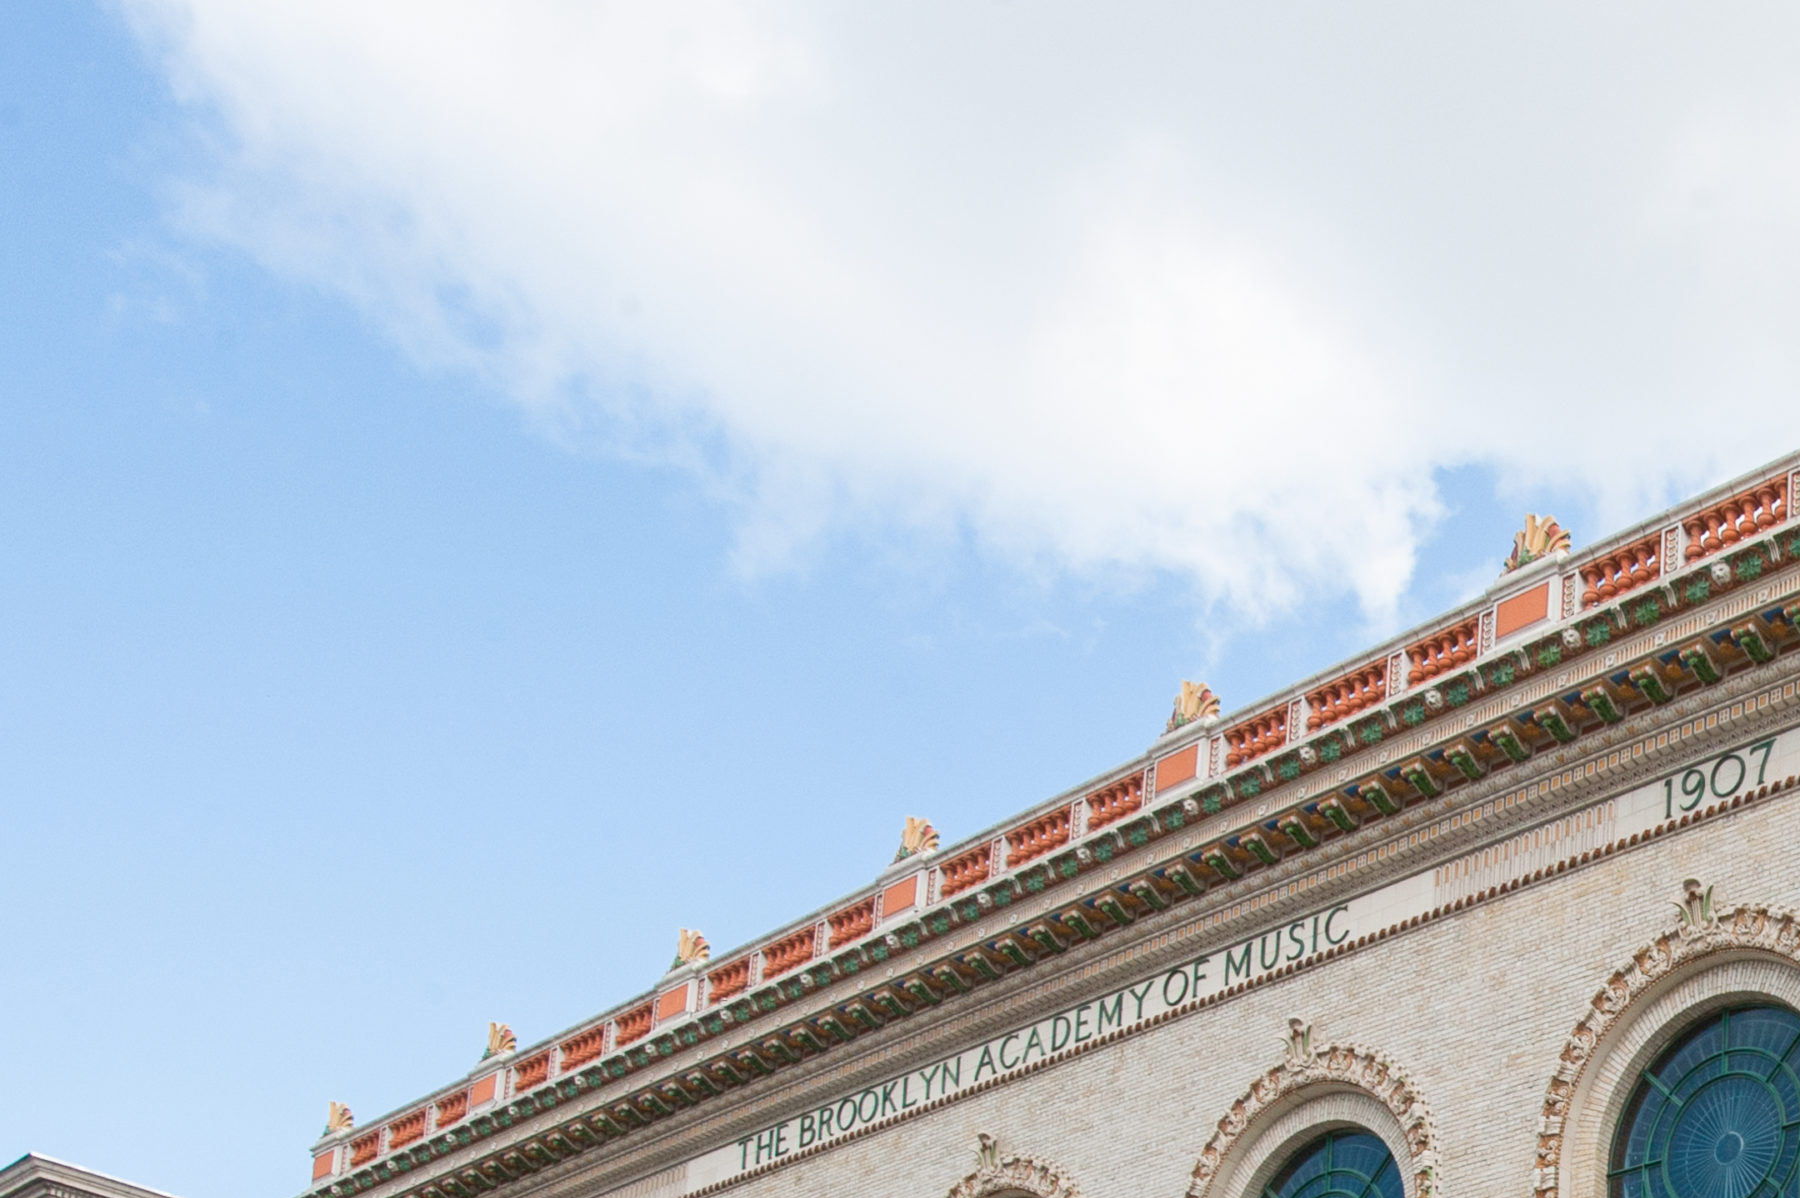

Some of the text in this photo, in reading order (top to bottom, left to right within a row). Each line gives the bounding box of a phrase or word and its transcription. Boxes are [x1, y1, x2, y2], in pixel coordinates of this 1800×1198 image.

[1664, 738, 1776, 820] 1907
[738, 905, 1350, 1170] THE BROOKLYN ACADEMY OF MUSIC
